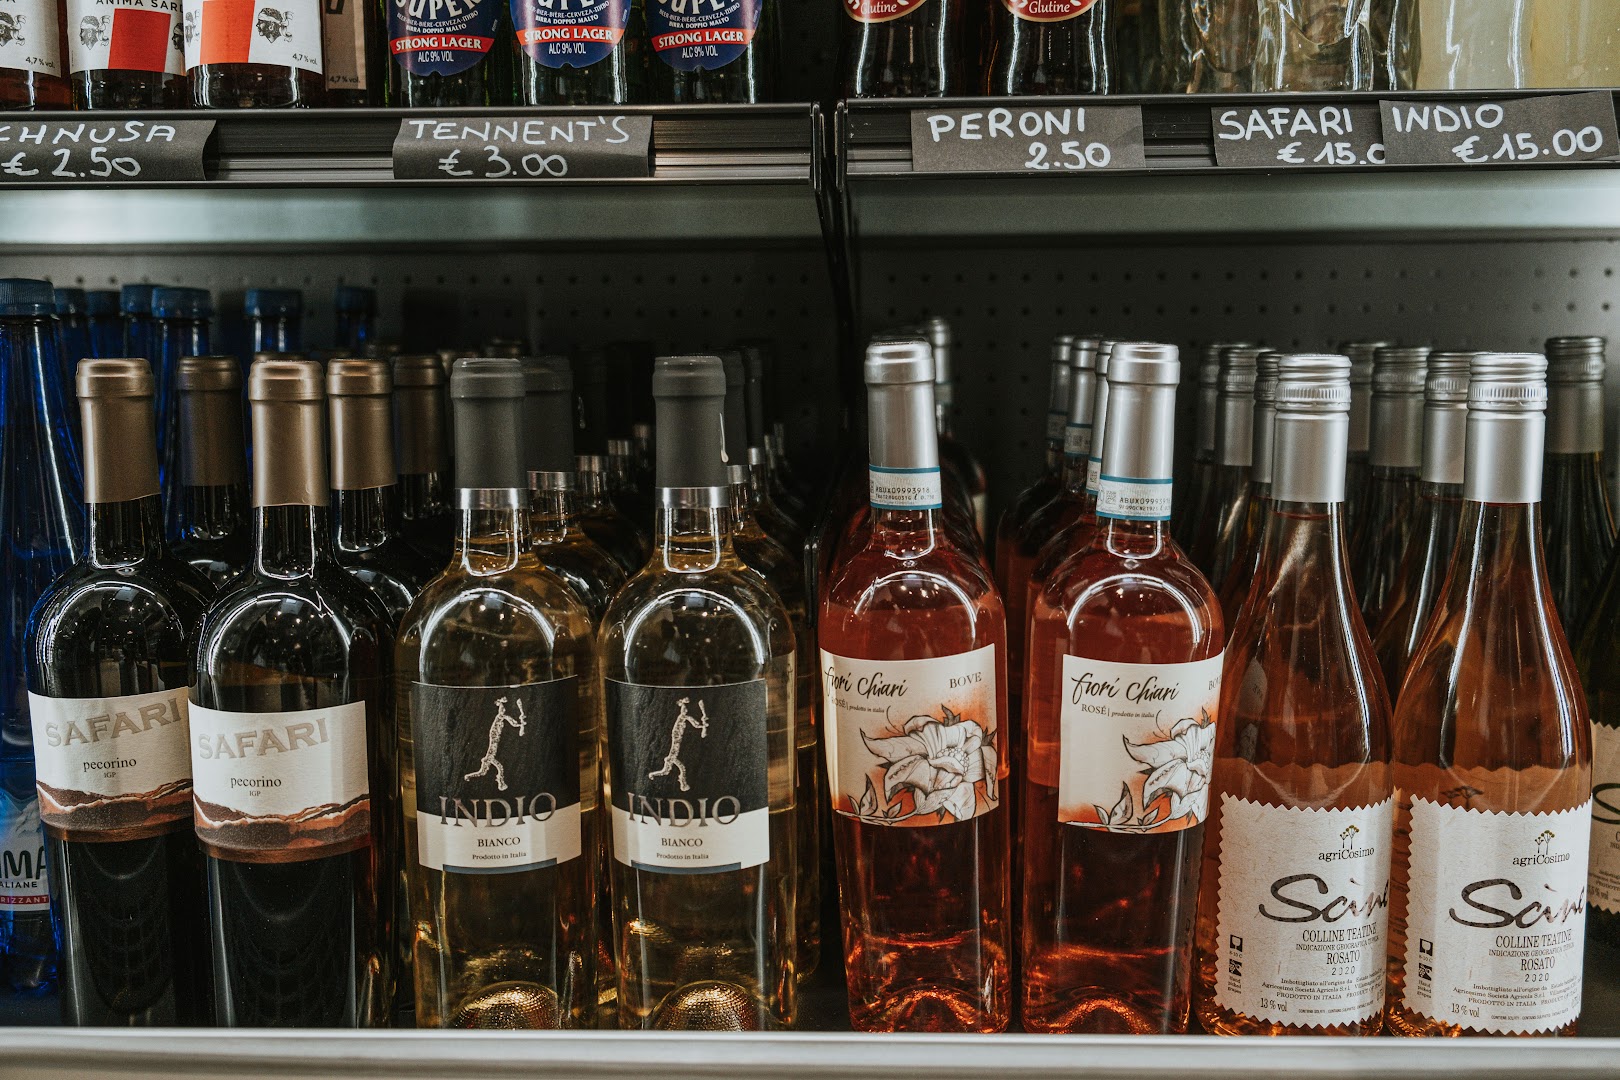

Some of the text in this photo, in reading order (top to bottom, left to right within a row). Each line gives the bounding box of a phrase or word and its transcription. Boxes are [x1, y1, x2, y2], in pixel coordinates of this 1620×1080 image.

[859, 1, 897, 14] Glutine
[1028, 0, 1071, 13] Glutine
[578, 14, 599, 23] MALTO
[685, 21, 708, 29] DOPPIO
[709, 16, 730, 26] MALTO
[446, 23, 467, 32] MALTO
[524, 27, 613, 42] STRONG LAGER
[395, 36, 482, 51] STRONG LAGER
[658, 30, 745, 48] STRONG LAGER
[548, 42, 587, 55] ALC 9% VOL
[681, 45, 718, 59] ALC 9% VOL
[417, 51, 454, 62] ALC 9% VOL
[926, 107, 1086, 143] PERONI
[1218, 107, 1353, 141] SAFARI
[1391, 104, 1504, 134] INDIO
[408, 115, 630, 146] TENNENT'S
[52, 146, 142, 177] 2.50
[485, 145, 568, 178] 3.00
[1024, 141, 1112, 170] 2.50
[857, 671, 909, 699] Chiari
[949, 672, 983, 689] BOVE
[1071, 672, 1180, 705] fiori Chiari
[45, 697, 182, 748] SAFARI
[1111, 711, 1135, 719] prodotto
[198, 717, 330, 760] SAFARI
[83, 757, 137, 772] pecorino
[230, 775, 282, 789] pecorino
[438, 792, 557, 828] INDIO
[627, 792, 741, 828] INDIO
[477, 836, 521, 847] BIANCO
[661, 837, 703, 848] BIANCO
[656, 852, 684, 860] Prodotto
[1318, 847, 1375, 863] agriCosimo
[1512, 852, 1570, 867] agriCosimo
[1302, 922, 1377, 943] COLLINE TEATINE
[1495, 928, 1572, 949] COLLINE TEATINE
[1296, 943, 1336, 951] INDICAZIONE
[1488, 949, 1530, 958] INDICAZIONE
[1326, 950, 1361, 965] ROSATO
[1520, 955, 1556, 971] ROSATO
[1276, 991, 1313, 1000] PRODOTTO
[1468, 997, 1506, 1007] PRODOTTO
[1260, 997, 1268, 1009] 13
[1277, 1001, 1288, 1012] vol
[1452, 1002, 1460, 1014] 13
[1469, 1007, 1480, 1018] vol
